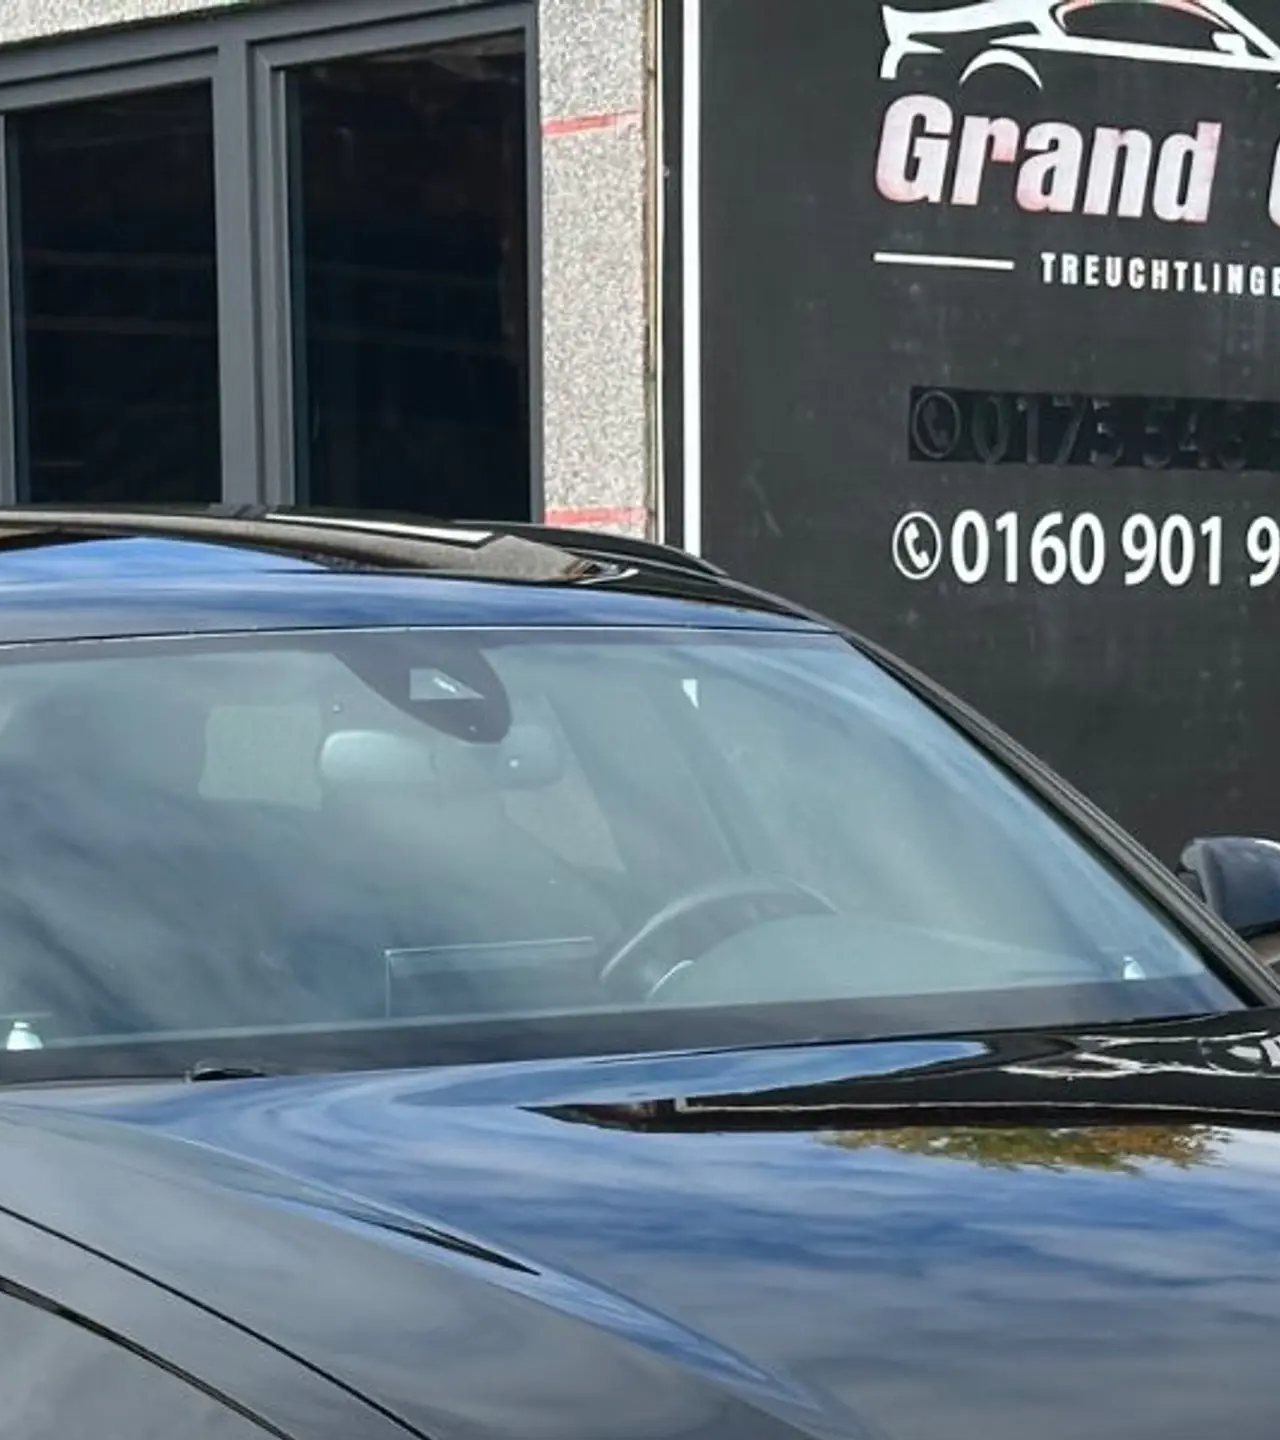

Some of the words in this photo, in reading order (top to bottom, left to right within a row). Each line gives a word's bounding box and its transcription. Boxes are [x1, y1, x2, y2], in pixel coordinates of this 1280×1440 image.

[875, 94, 1222, 223] Grand
[951, 508, 1106, 585] 0160
[1121, 512, 1223, 586] 901
